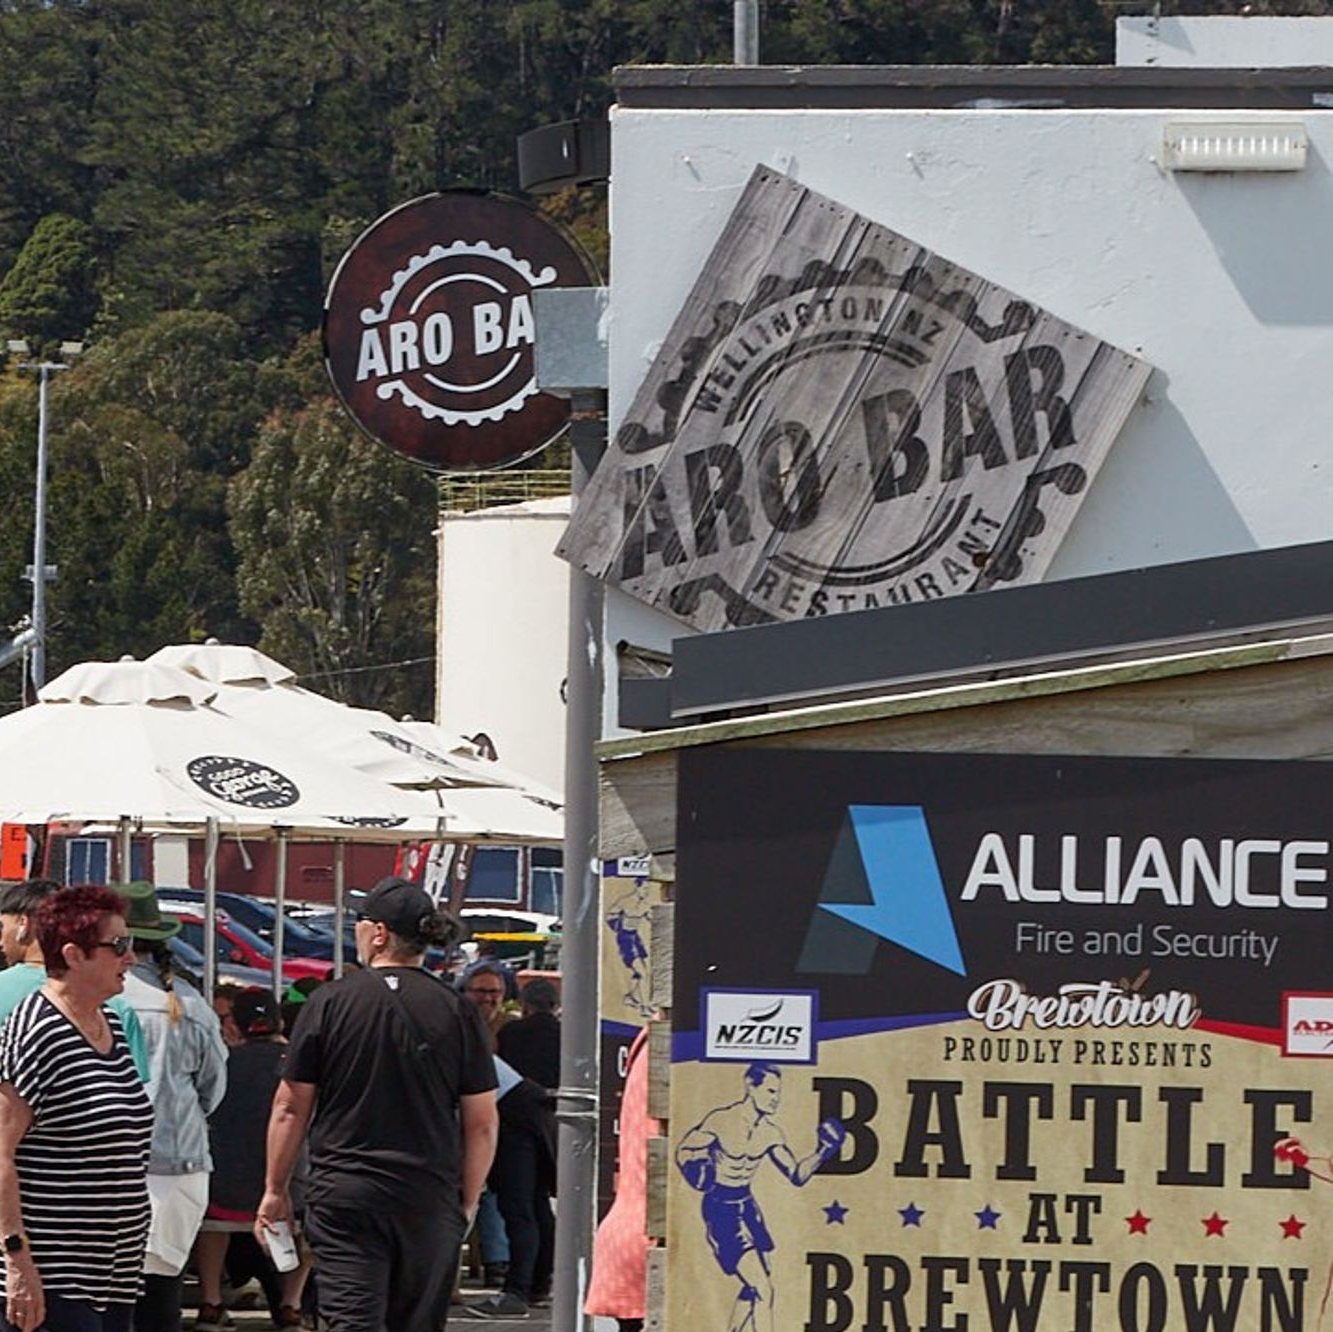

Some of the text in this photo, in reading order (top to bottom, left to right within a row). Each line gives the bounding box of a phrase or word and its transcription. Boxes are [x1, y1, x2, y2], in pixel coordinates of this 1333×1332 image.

[356, 294, 535, 382] ARO BA
[694, 296, 946, 415] WELLINGTON NZ
[619, 343, 1077, 581] ARO BAR
[960, 832, 1329, 910] ALLIANCE
[1015, 922, 1279, 967] Fire and Security
[716, 1024, 803, 1045] NZCIS
[967, 977, 1203, 1034] Brewtown
[943, 1036, 1213, 1069] PROUDLY PRESENTS
[811, 1076, 1313, 1189] BATTLE
[1022, 1192, 1103, 1246] AT
